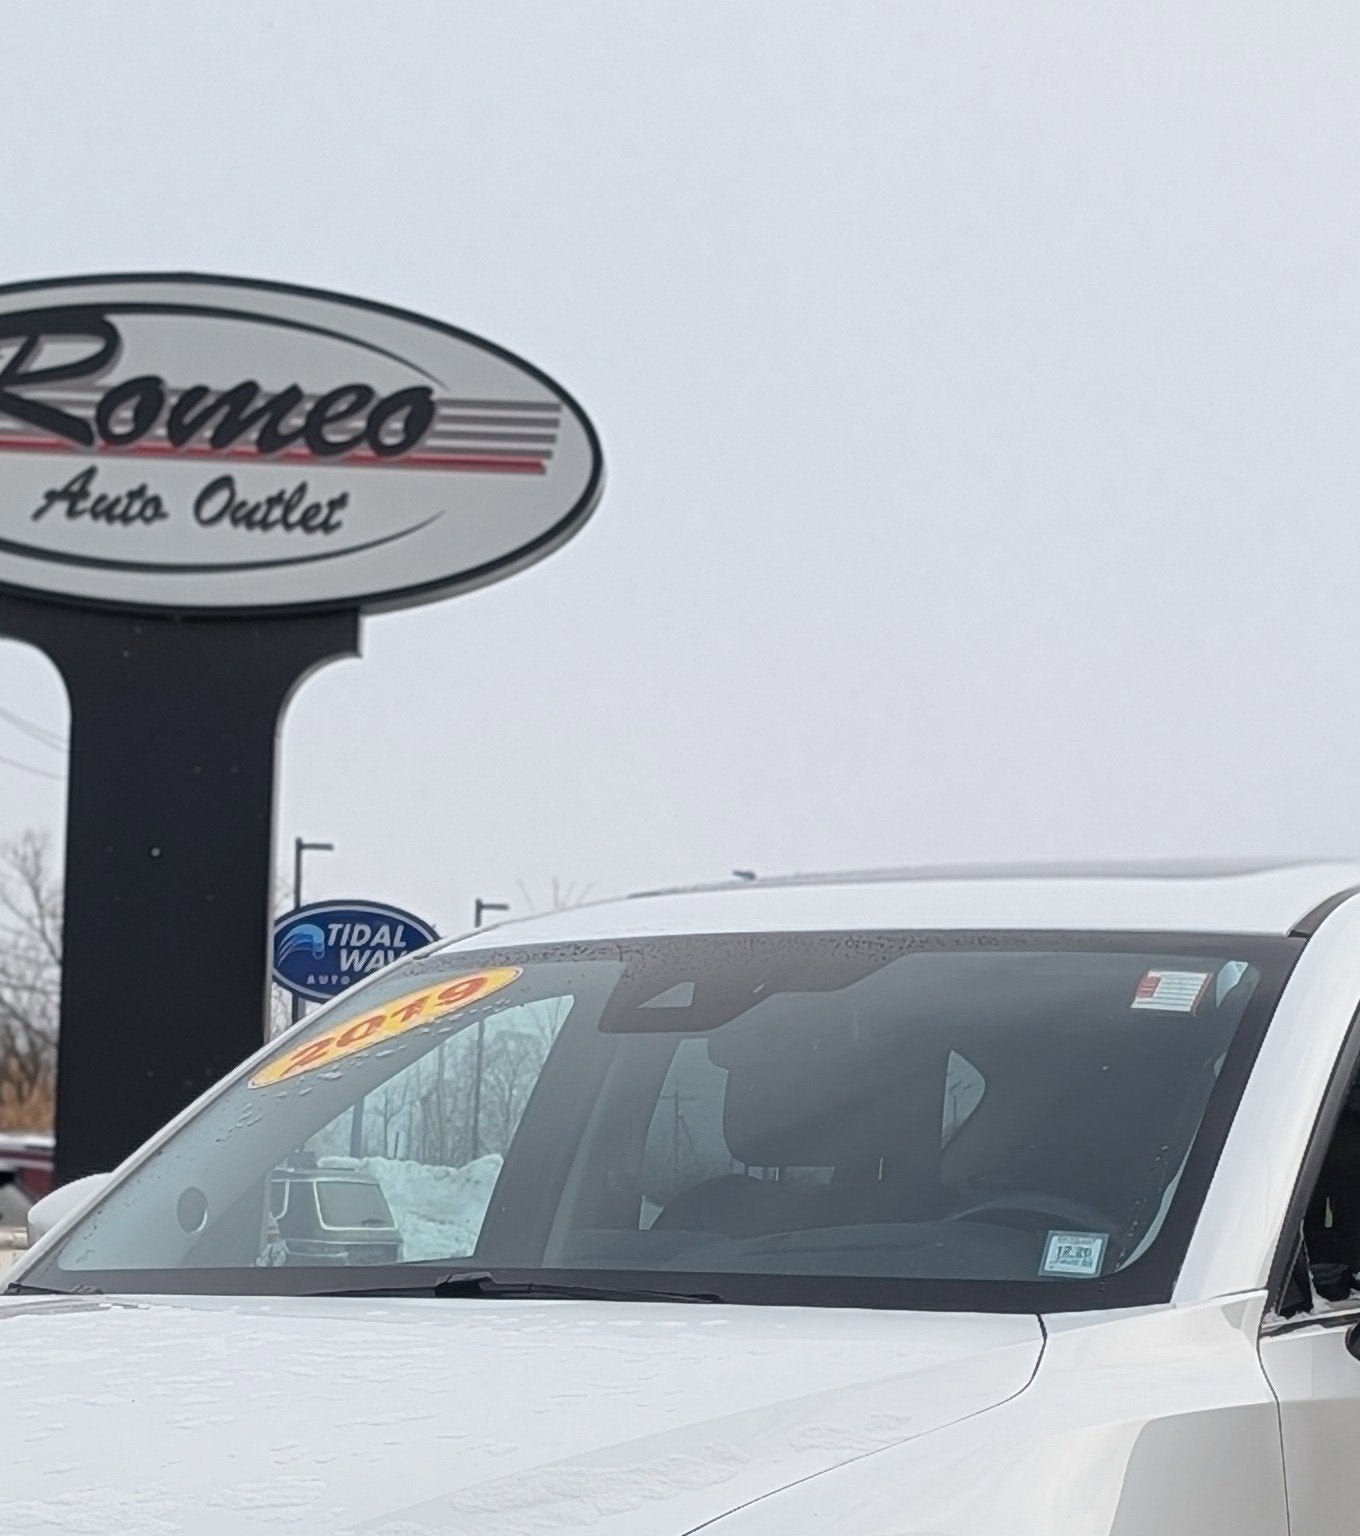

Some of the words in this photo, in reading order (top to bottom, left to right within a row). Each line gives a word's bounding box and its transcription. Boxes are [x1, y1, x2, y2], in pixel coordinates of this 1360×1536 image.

[31, 465, 169, 527] Auto
[193, 473, 350, 535] Outlet
[327, 922, 407, 948] TIDAL
[340, 949, 408, 972] WAV
[306, 974, 351, 985] AUTO
[281, 975, 489, 1077] 2019
